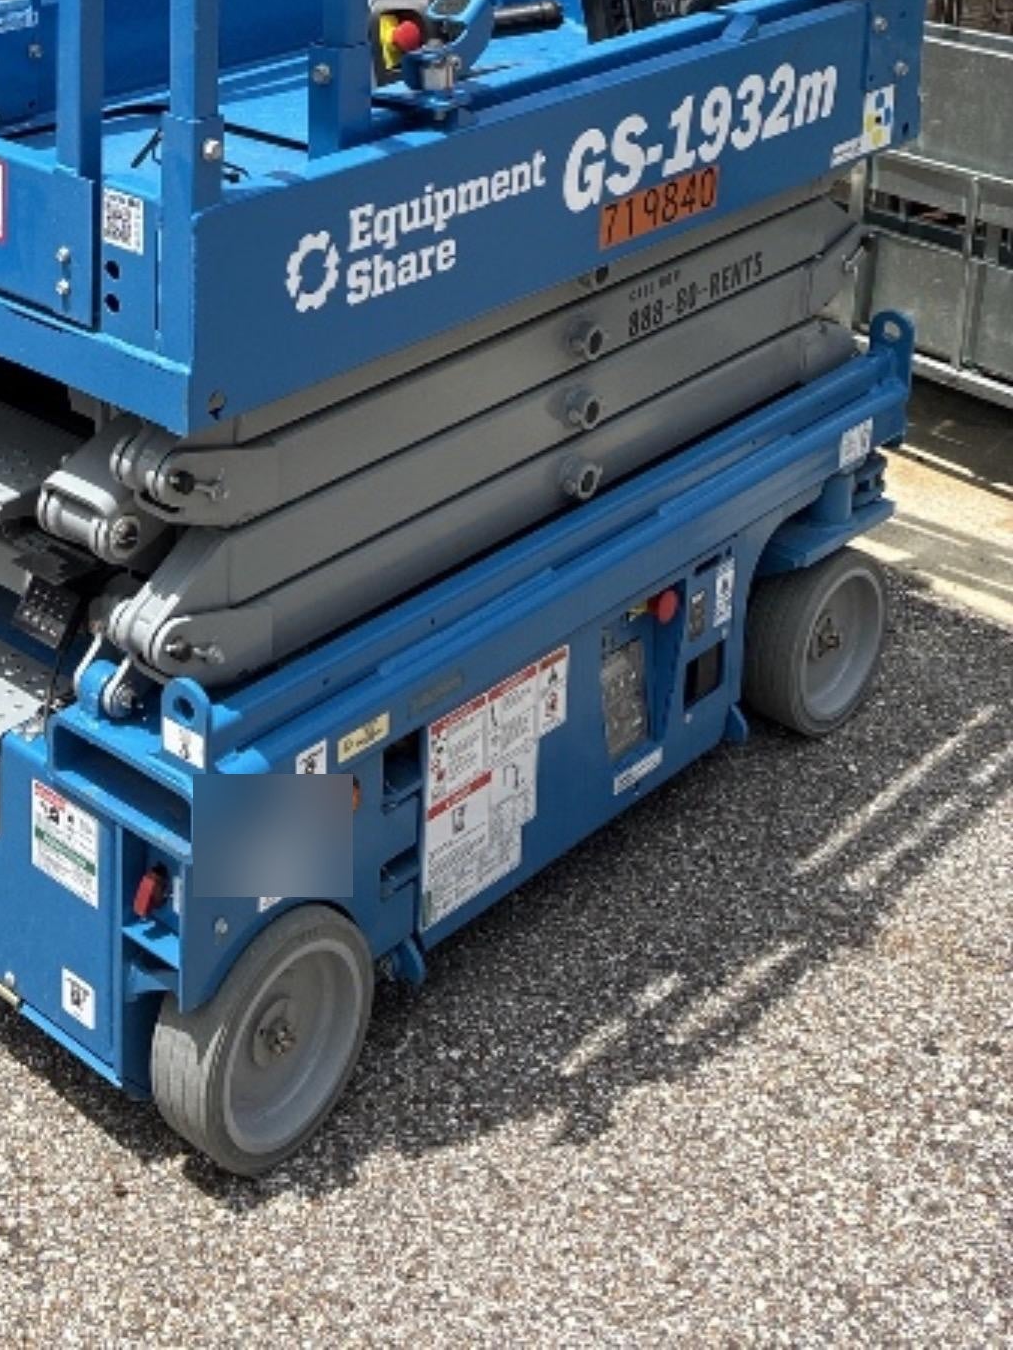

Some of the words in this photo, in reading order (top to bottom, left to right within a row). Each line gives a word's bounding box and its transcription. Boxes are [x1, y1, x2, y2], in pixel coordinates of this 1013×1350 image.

[563, 63, 837, 213] GS-1932m
[349, 149, 546, 251] Equipment
[604, 167, 716, 244] 719840
[346, 238, 456, 305] Share
